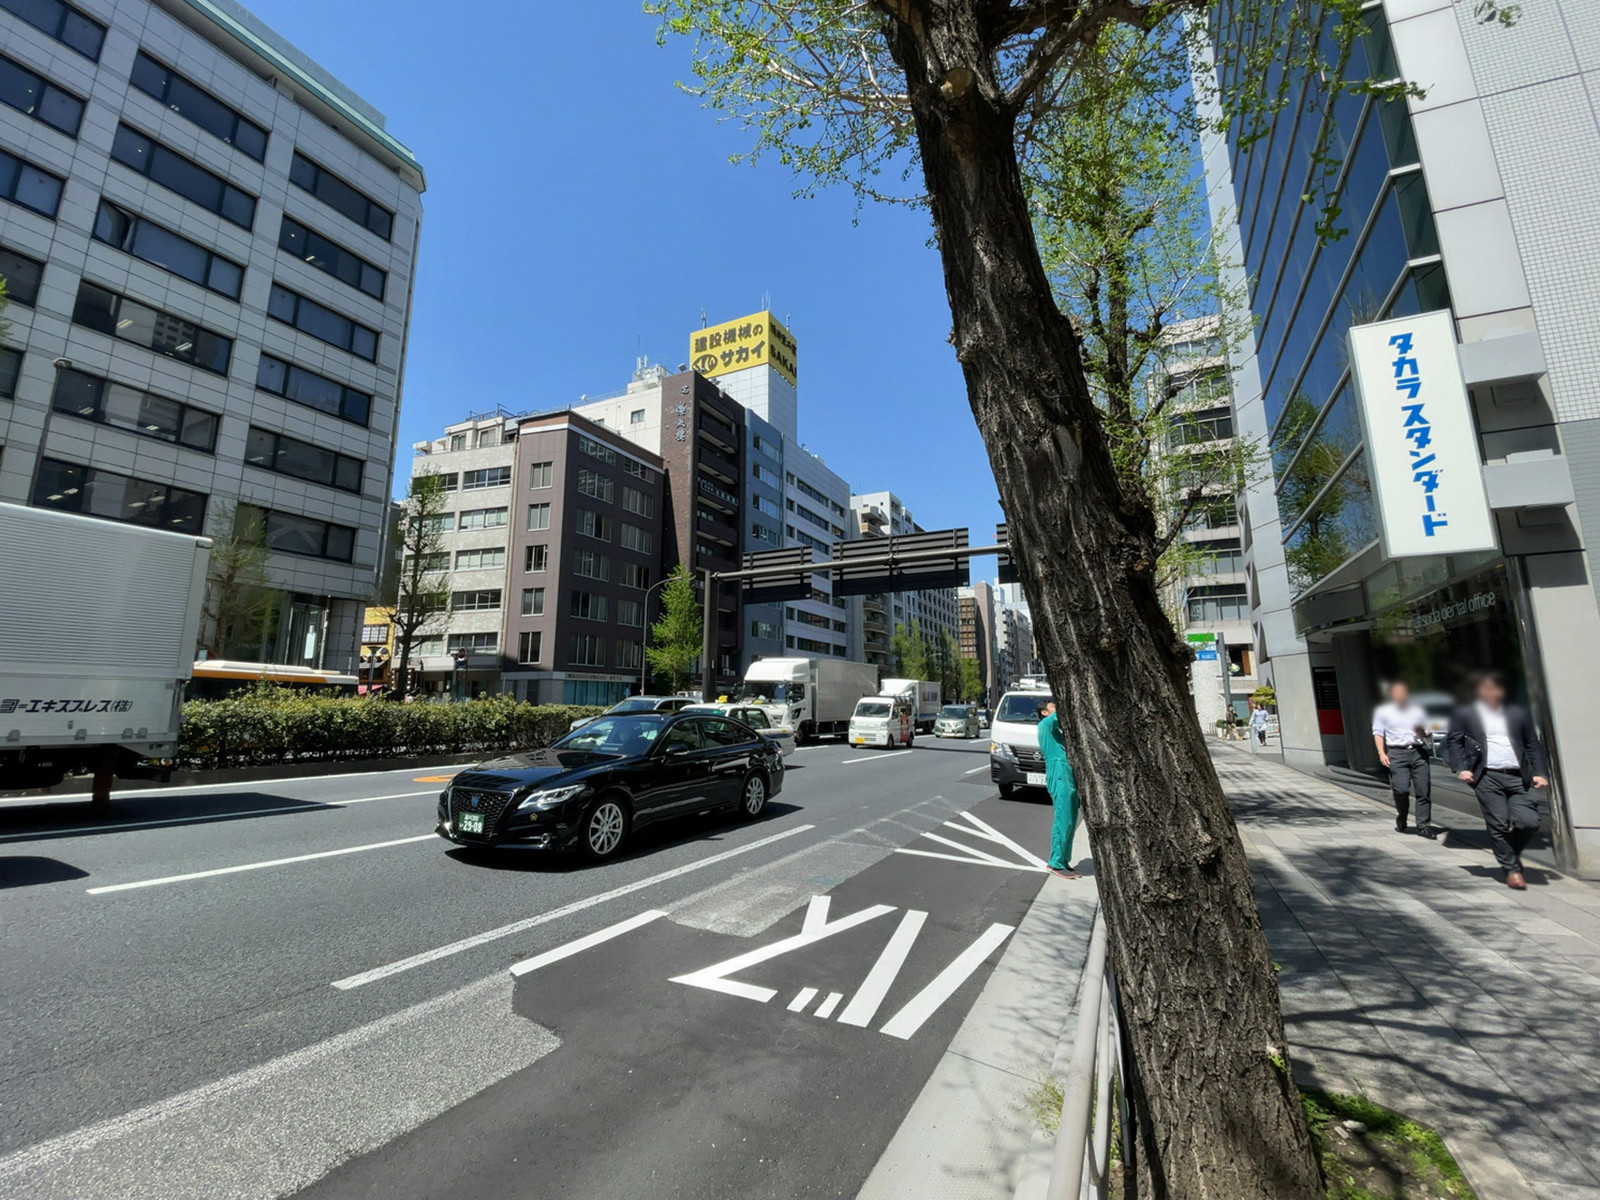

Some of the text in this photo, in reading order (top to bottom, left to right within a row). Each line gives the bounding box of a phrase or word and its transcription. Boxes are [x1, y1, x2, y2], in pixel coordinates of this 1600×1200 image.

[694, 322, 764, 353] 建設機械の
[720, 340, 766, 368] サカイ
[769, 343, 797, 379] SAKAI
[1388, 332, 1448, 537] タカラスタンダード
[1468, 591, 1496, 612] office
